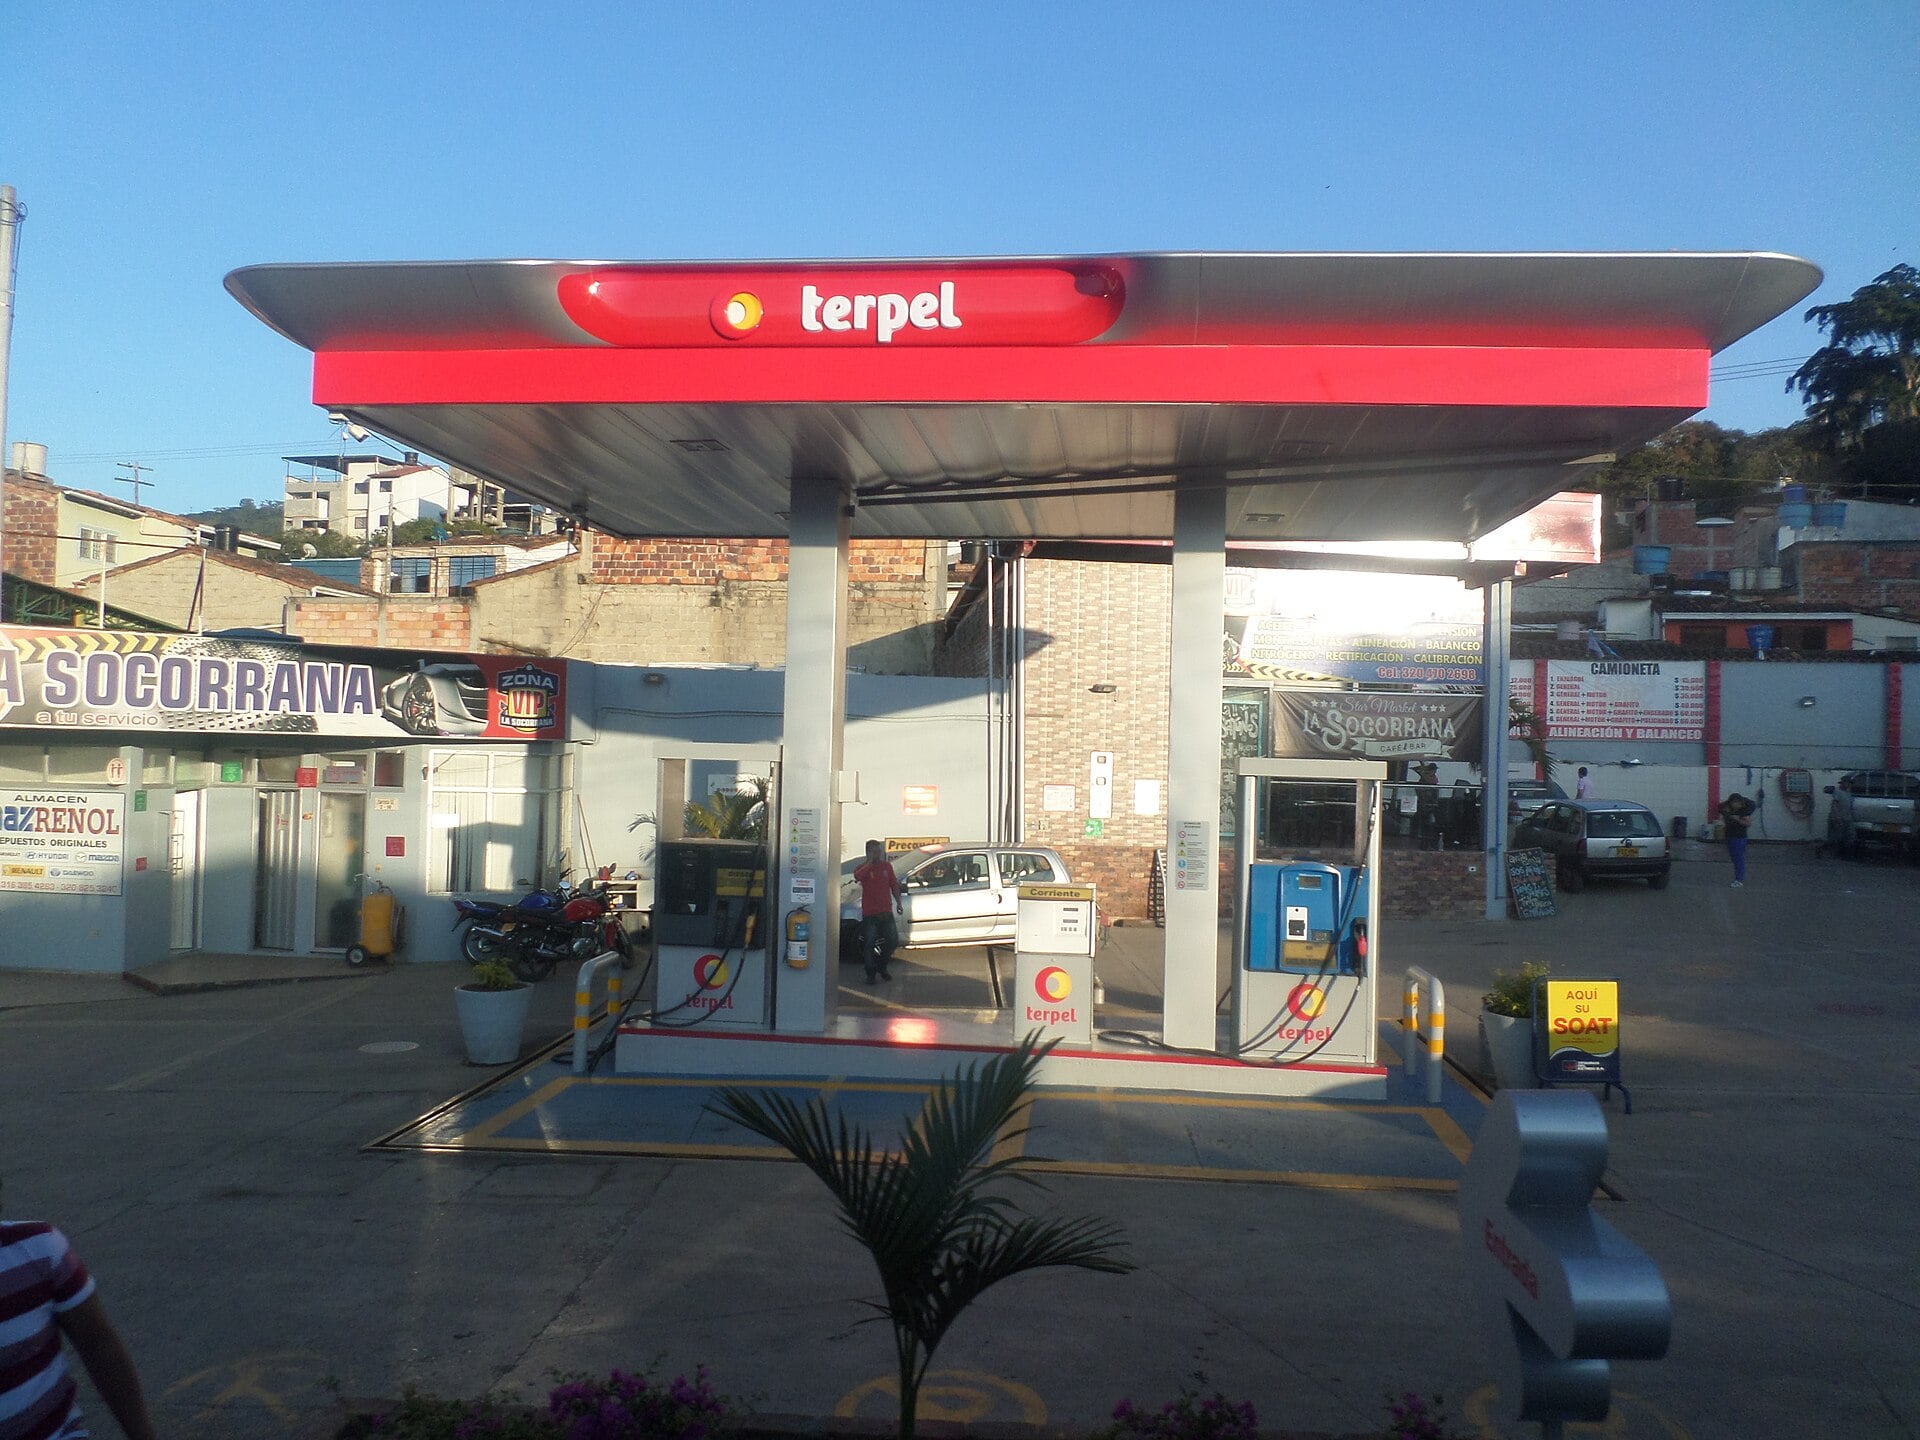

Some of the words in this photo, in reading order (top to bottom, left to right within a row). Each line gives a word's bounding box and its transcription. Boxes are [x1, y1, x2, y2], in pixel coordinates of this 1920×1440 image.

[801, 281, 963, 343] terpel
[1425, 641, 1481, 651] BALANCEO
[1251, 647, 1316, 660] NITRÓGENO
[1325, 650, 1404, 662] RECTIFICACIÓN
[1413, 652, 1483, 665] CALIBRACIÓN
[1402, 667, 1424, 679] 320
[1591, 663, 1660, 676] CAMIONETA
[43, 650, 376, 716] SOCORRANA
[502, 674, 554, 689] ZONA
[512, 690, 545, 716] VIP
[1340, 697, 1368, 713] Star
[1370, 696, 1417, 713] Market
[37, 713, 51, 725] a
[56, 711, 77, 725] tu
[82, 712, 159, 727] servicio
[501, 716, 511, 726] LA
[1321, 709, 1456, 750] SOCORRANA
[1549, 723, 1622, 738] ALINEACIÓN
[1626, 728, 1634, 738] Y
[1636, 729, 1702, 740] BALANCEO
[15, 794, 88, 803] ALMACEN
[50, 839, 108, 849] ORIGINALES
[12, 867, 43, 875] RENAULT
[1030, 888, 1080, 898] Corriente
[1566, 988, 1598, 1000] AQUÍ
[685, 993, 734, 1012] terpel
[1575, 1004, 1590, 1013] SU
[1026, 1006, 1077, 1025] terpel
[1553, 1017, 1612, 1035] SOAT
[1278, 1024, 1332, 1045] terpel
